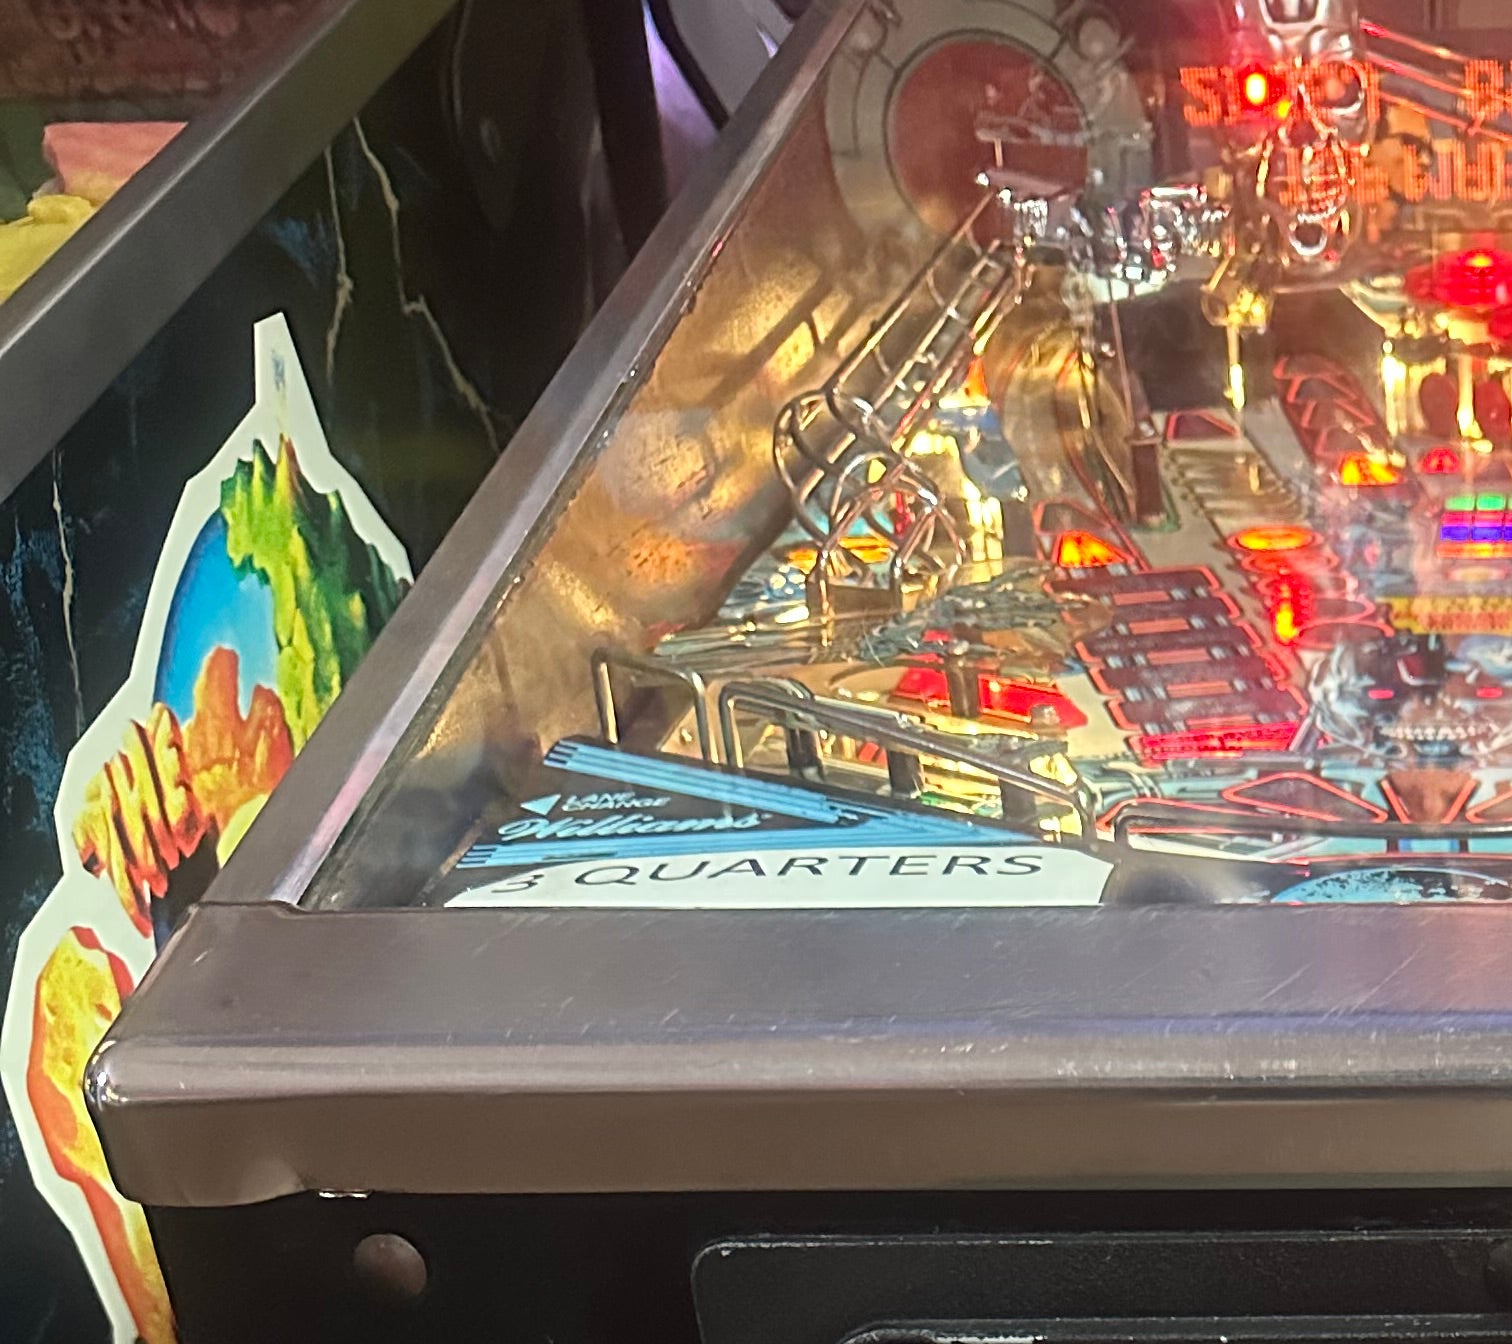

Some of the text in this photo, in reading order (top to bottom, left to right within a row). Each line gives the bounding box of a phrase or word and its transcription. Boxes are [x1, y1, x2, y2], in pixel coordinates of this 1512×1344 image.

[498, 813, 761, 841] Williams
[491, 855, 1043, 893] 3 QUARTERS
